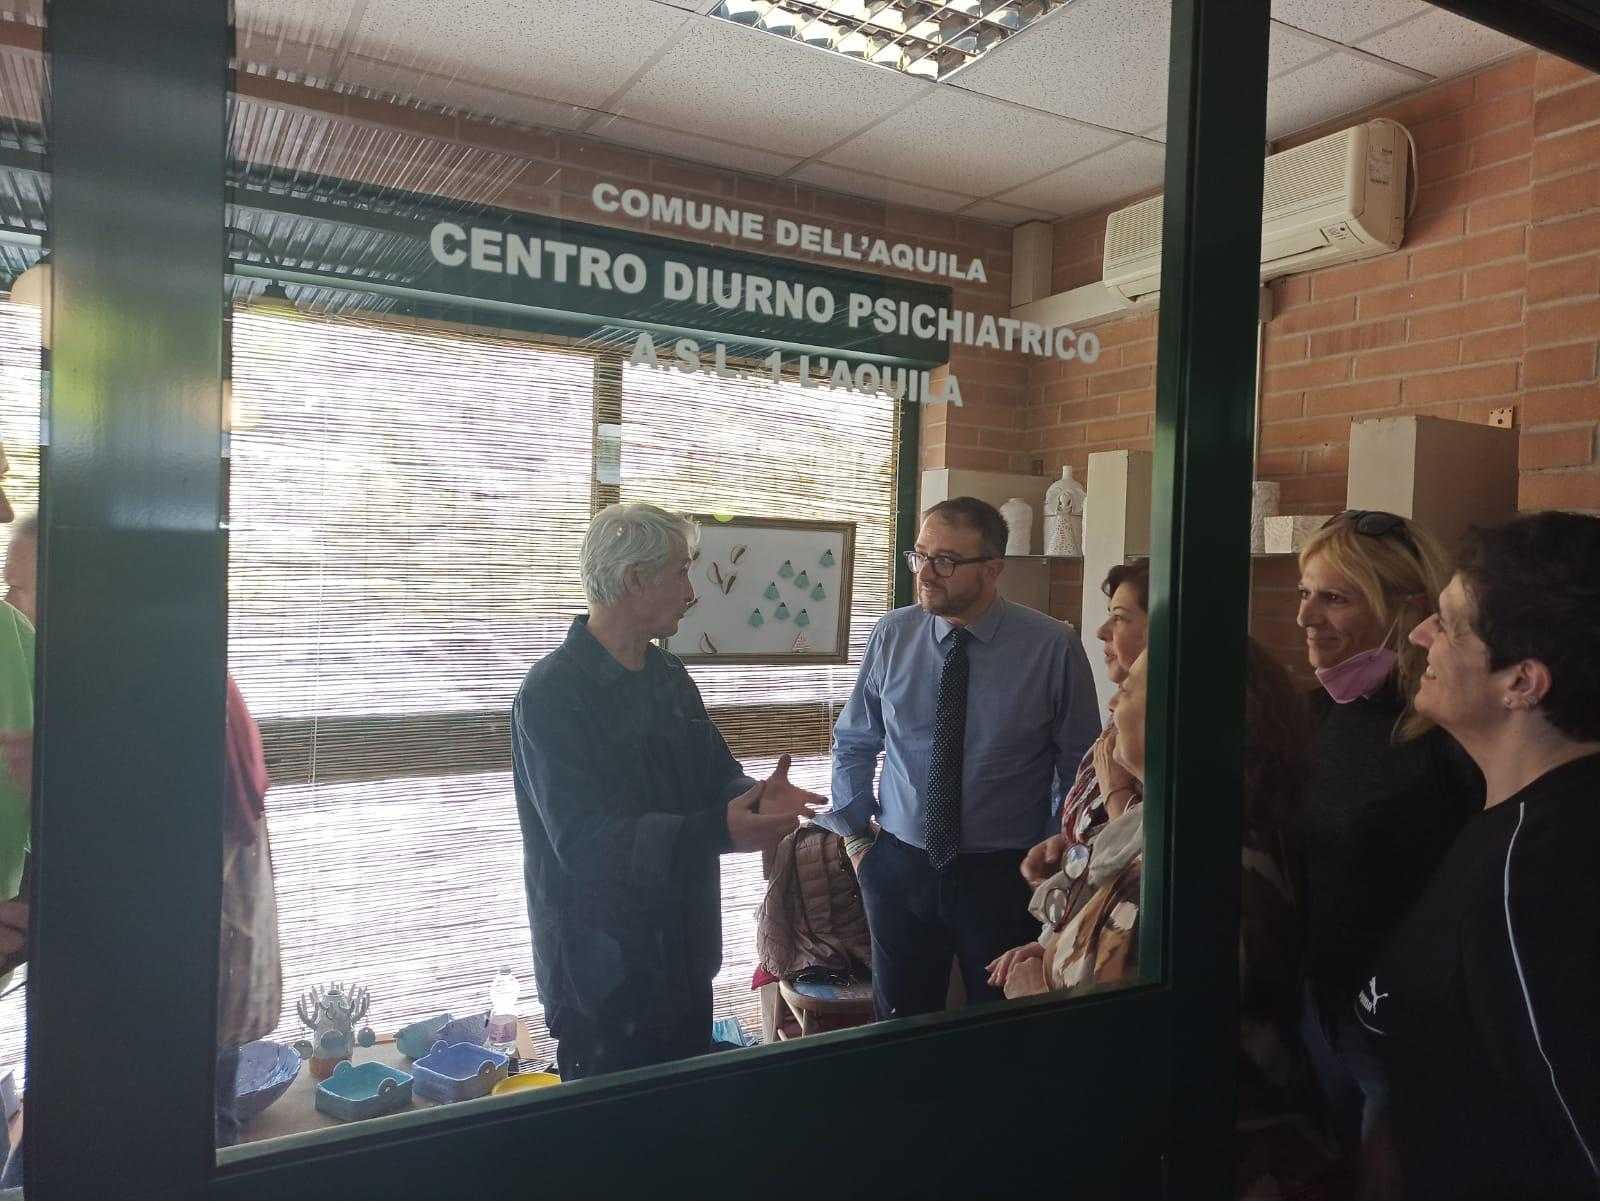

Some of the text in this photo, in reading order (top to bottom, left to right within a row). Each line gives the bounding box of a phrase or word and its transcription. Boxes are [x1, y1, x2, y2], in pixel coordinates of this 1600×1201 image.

[592, 183, 988, 282] COMUNE DELL'AQUILA
[430, 222, 1100, 364] CENTRO DIURNO PSICHIATRICO
[630, 333, 963, 407] A.S.L. 1 L'AQUILA
